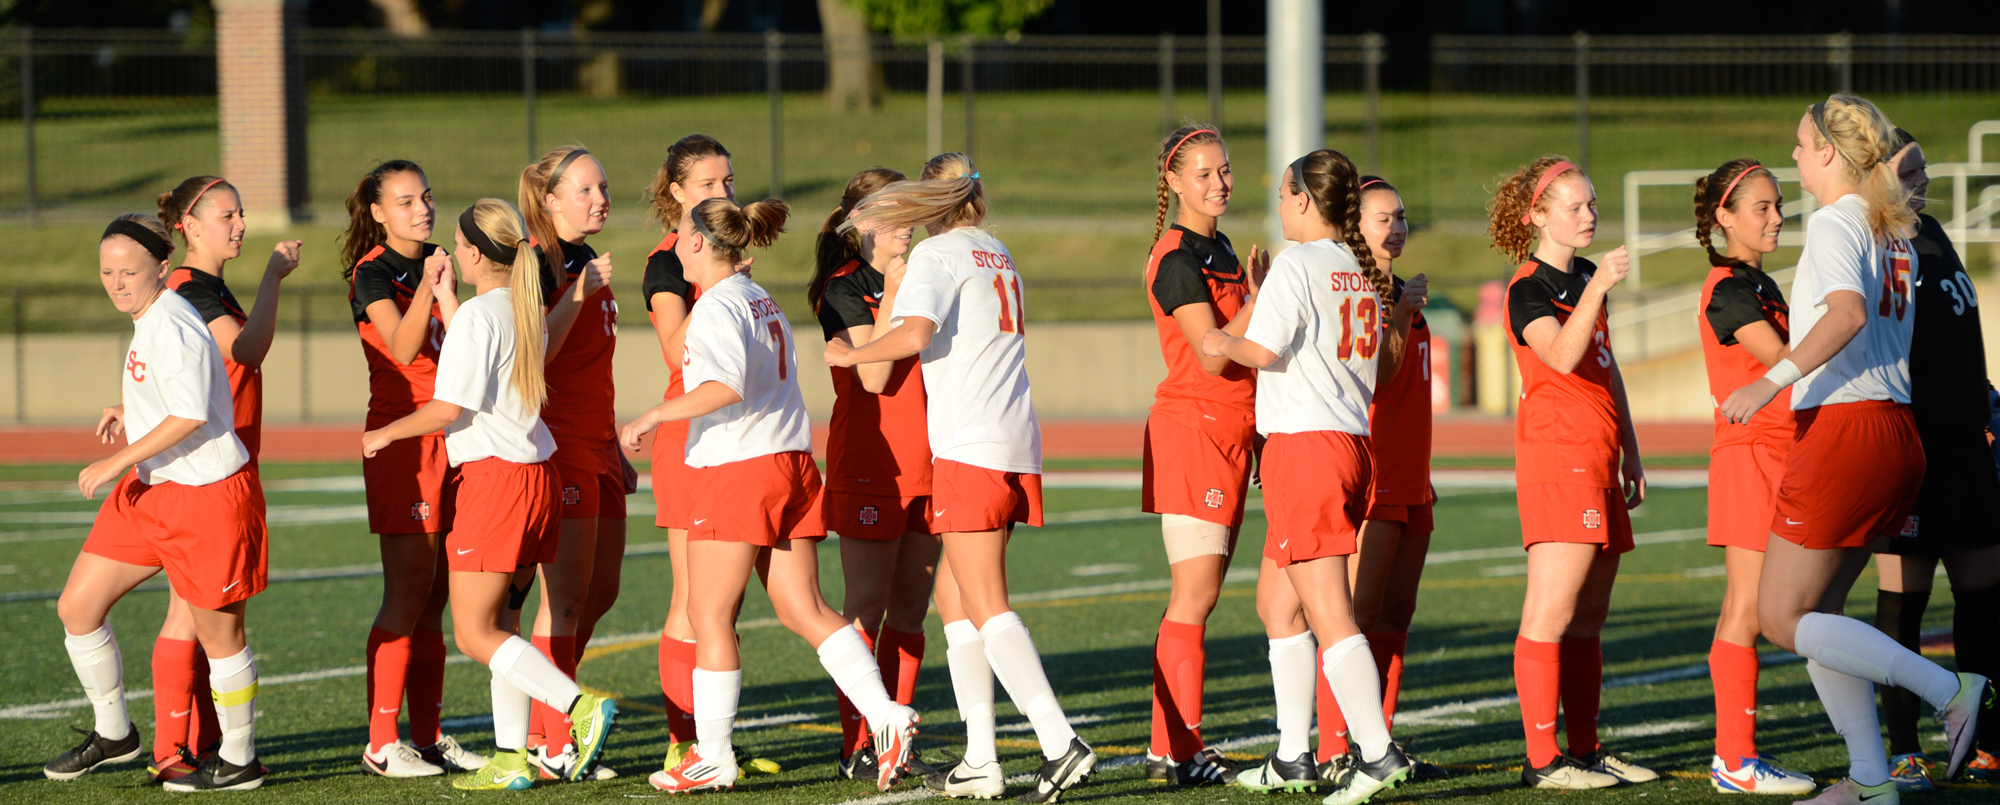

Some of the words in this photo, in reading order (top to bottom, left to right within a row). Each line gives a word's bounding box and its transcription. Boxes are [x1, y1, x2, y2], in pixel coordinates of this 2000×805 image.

[1331, 271, 1376, 292] STOR
[1879, 252, 1911, 322] 15
[1941, 271, 1977, 316] 30
[993, 273, 1025, 336] 11
[767, 319, 788, 381] 7
[1337, 296, 1378, 360] 13
[1595, 330, 1611, 368] 3
[127, 350, 146, 383] SC
[1417, 341, 1429, 381] 7
